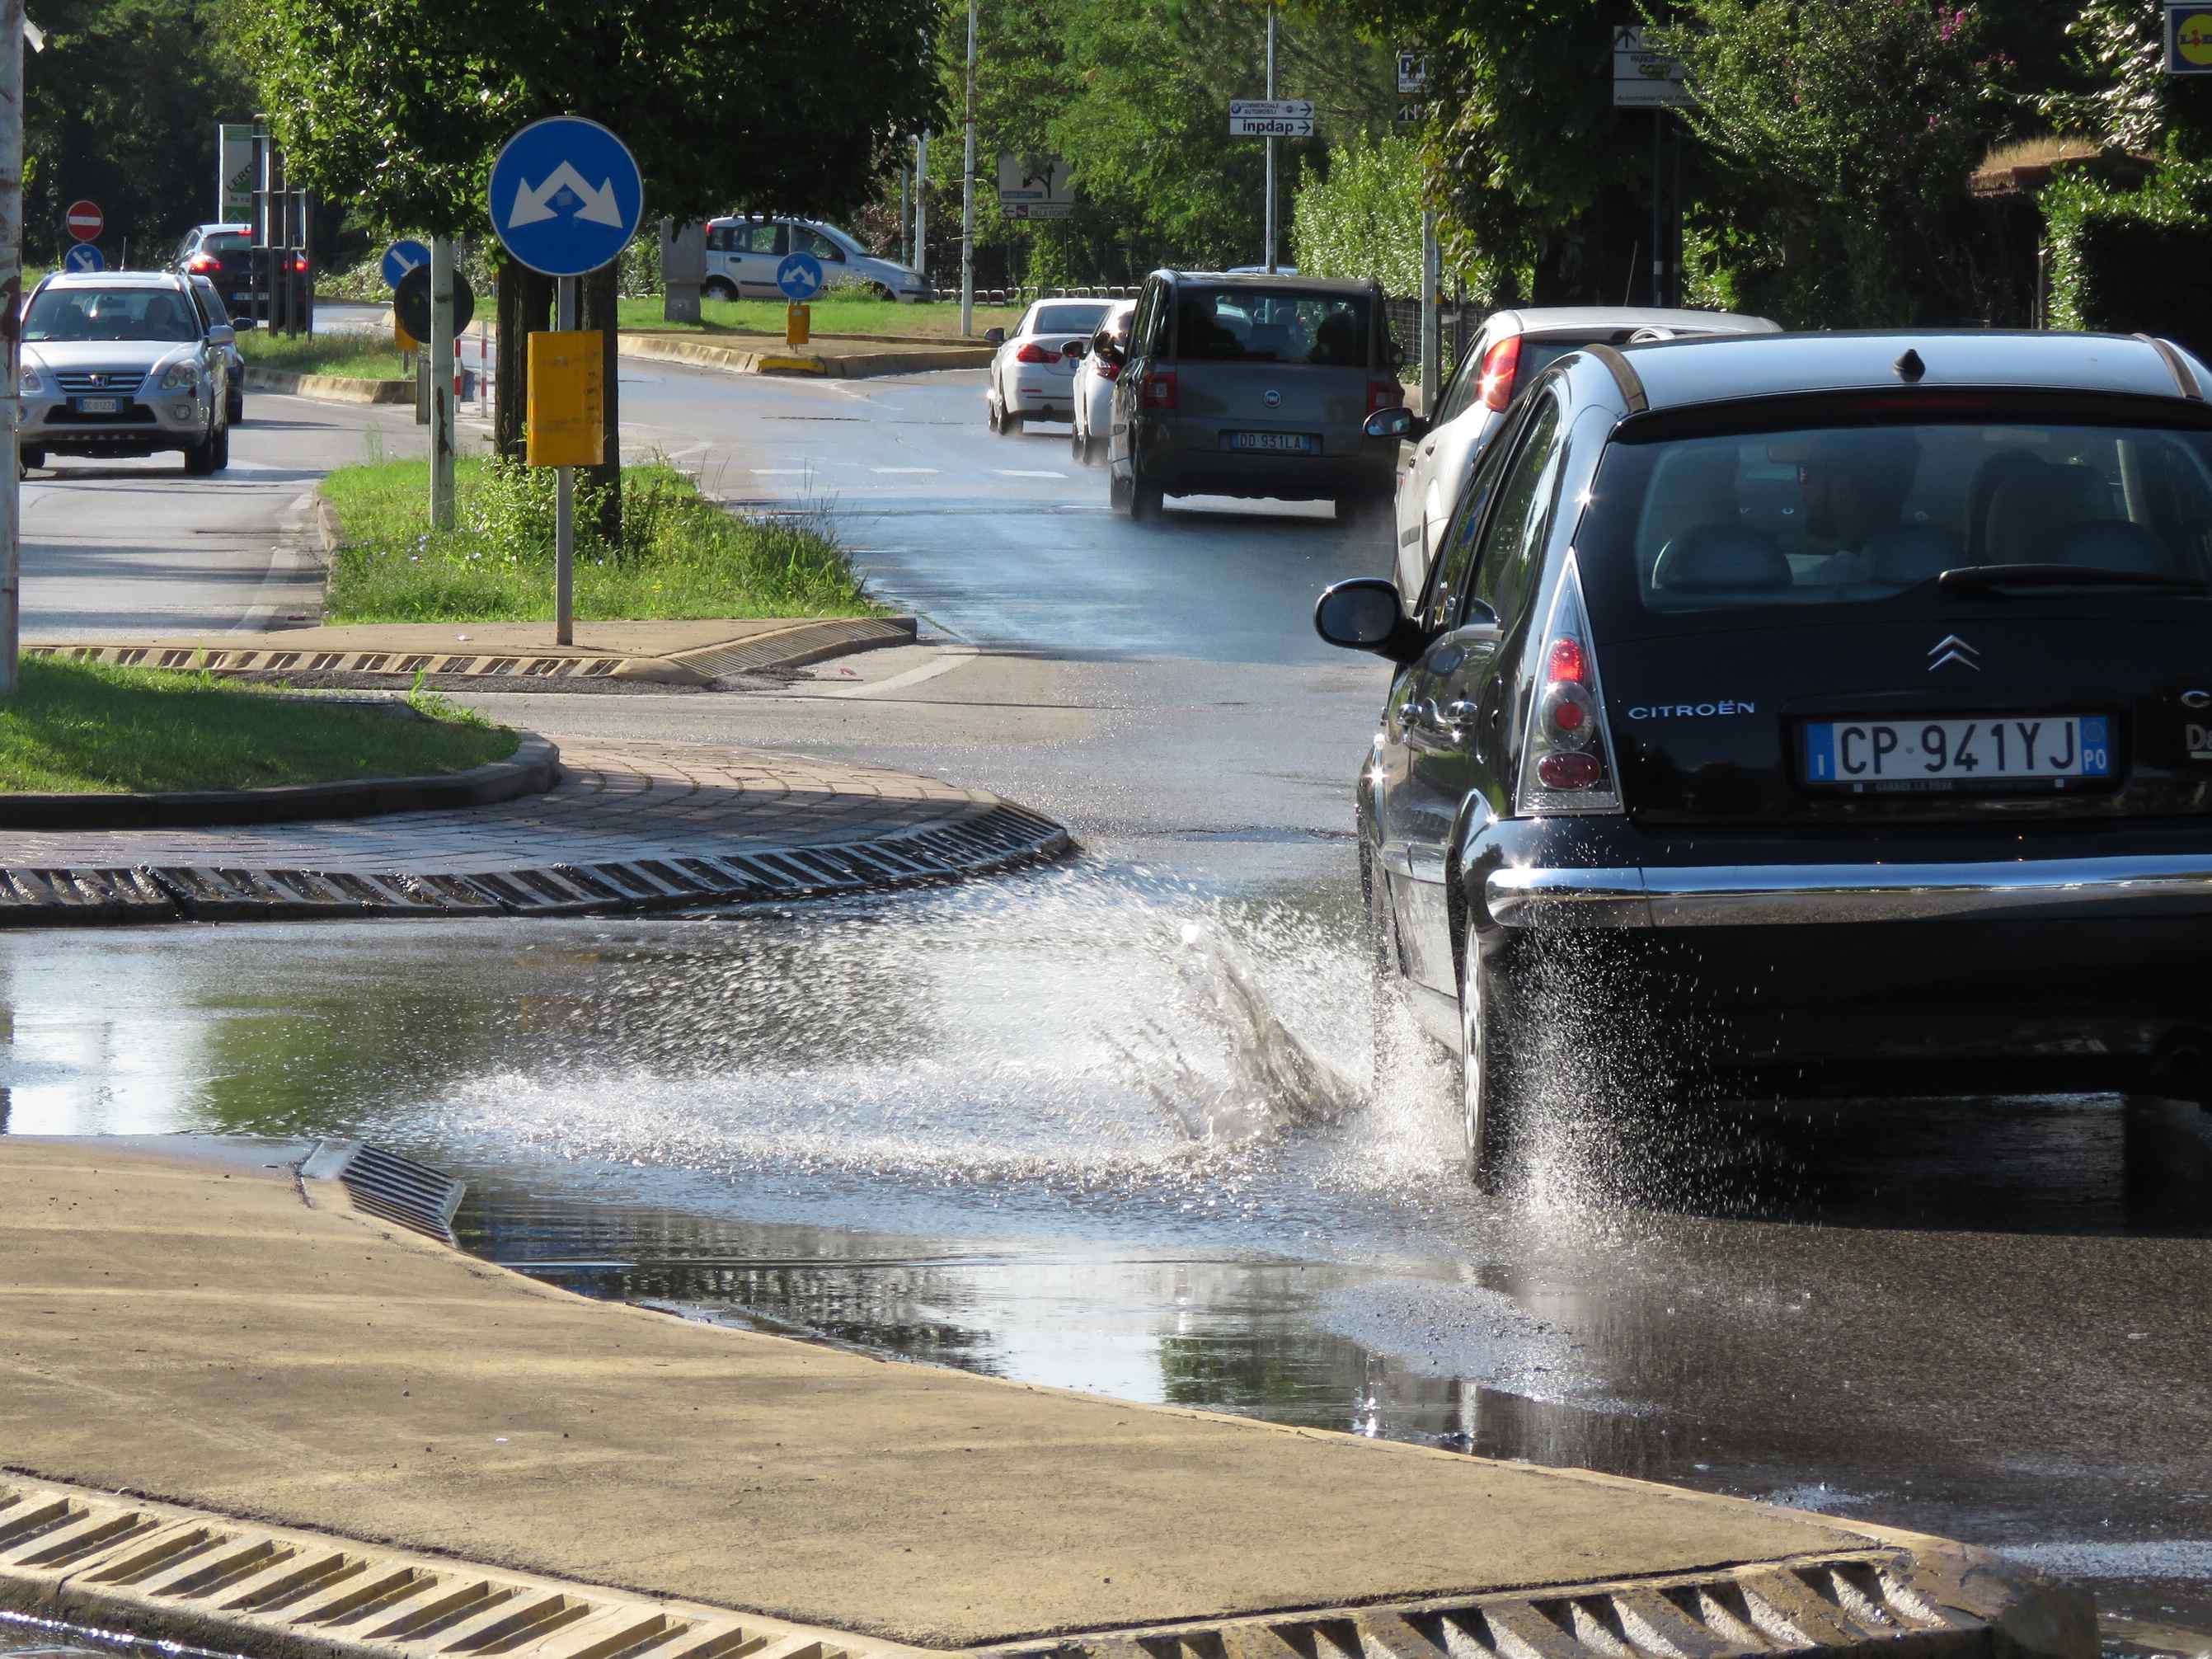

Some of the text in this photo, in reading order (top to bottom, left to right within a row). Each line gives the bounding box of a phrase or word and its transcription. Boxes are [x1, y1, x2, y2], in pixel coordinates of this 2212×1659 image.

[1242, 120, 1294, 134] inpdap
[1240, 434, 1256, 448] DD
[1628, 699, 1755, 720] CITROËN
[1839, 721, 2075, 775] CP 941YJ
[2083, 749, 2107, 771] PO
